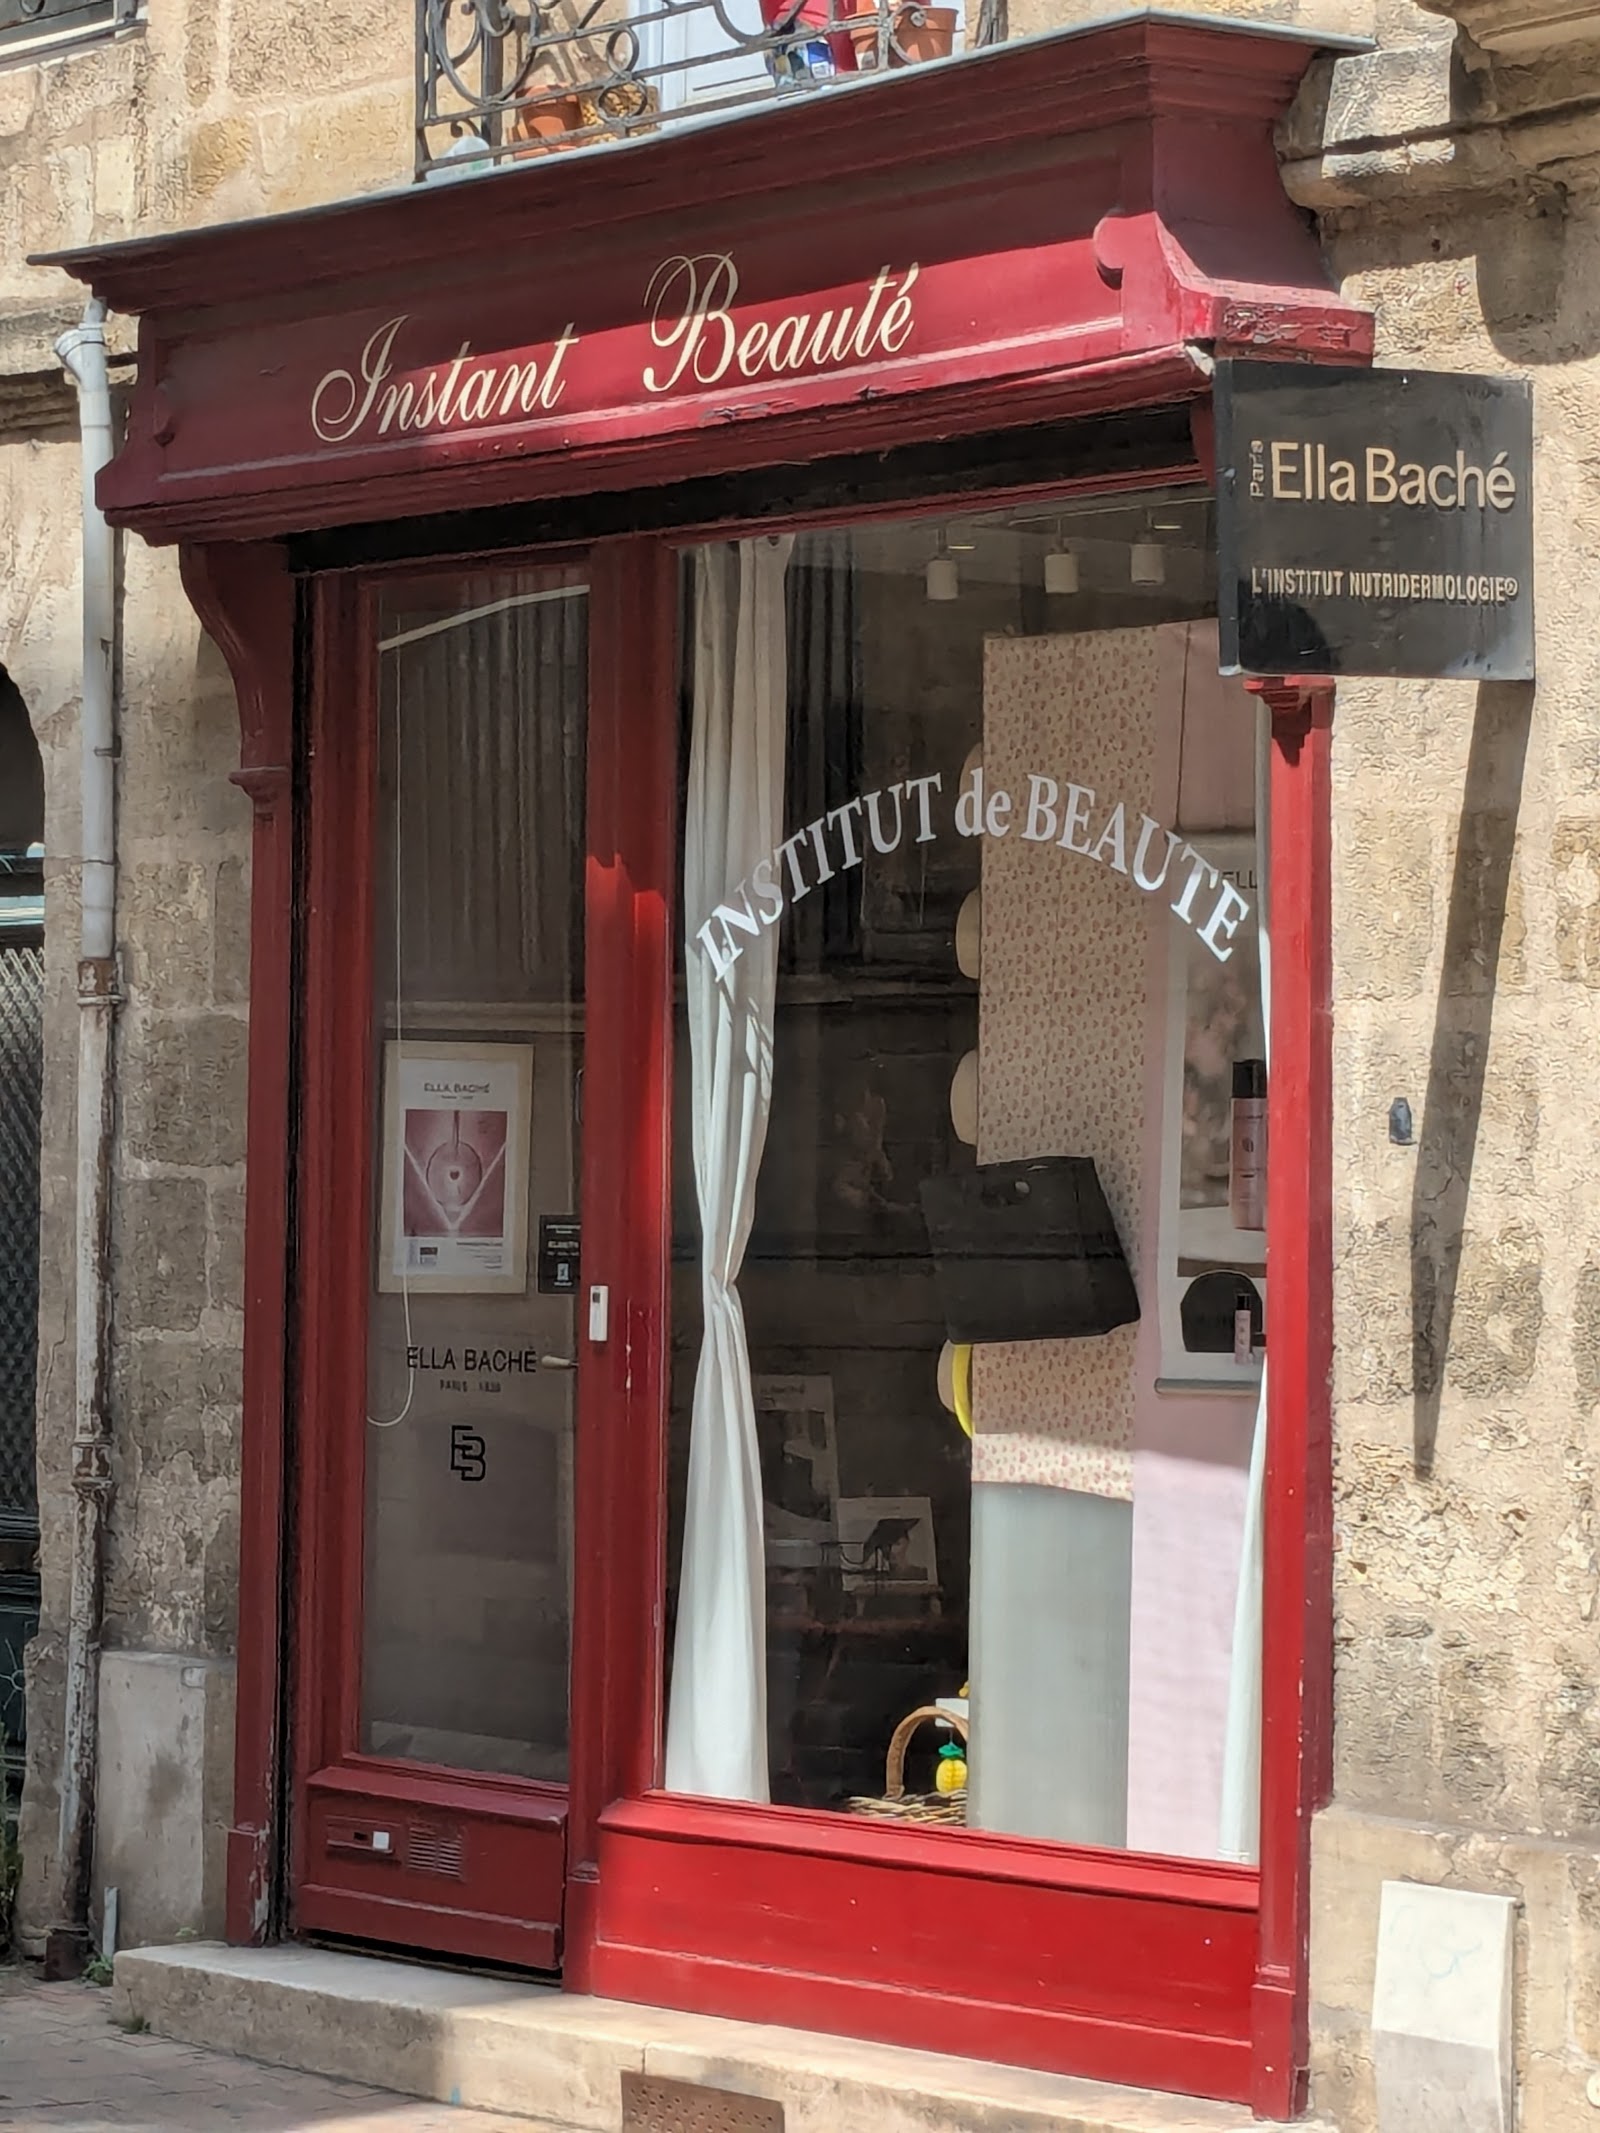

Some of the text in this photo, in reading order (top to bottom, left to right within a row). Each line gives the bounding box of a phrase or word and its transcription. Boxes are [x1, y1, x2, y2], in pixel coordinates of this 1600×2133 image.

[311, 251, 919, 443] Instant Beauté
[1249, 440, 1264, 498] Paris
[1270, 441, 1517, 509] Ella Baché
[1251, 567, 1345, 598] L'INSTITUT
[695, 767, 1250, 984] INSTITUT de BEAUTE
[406, 1346, 456, 1370] ELLA
